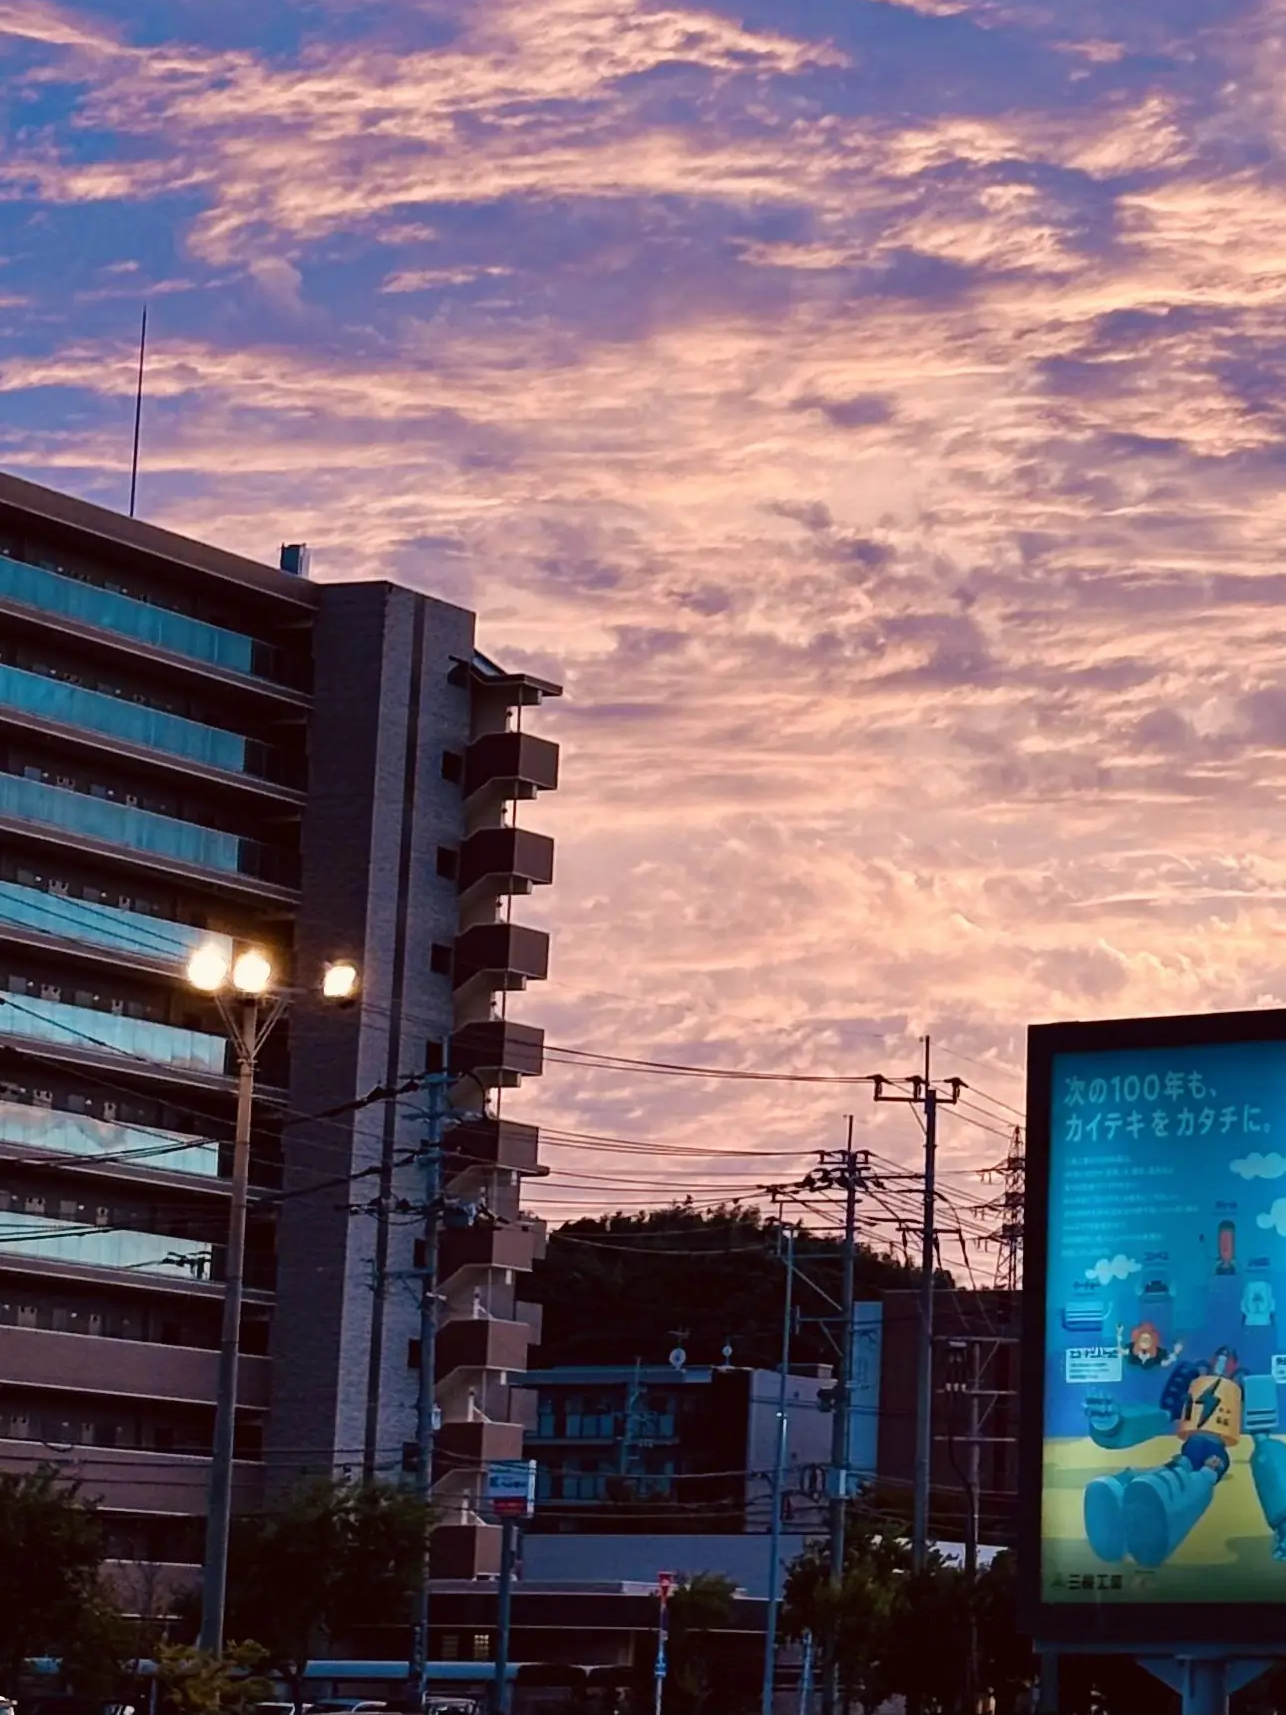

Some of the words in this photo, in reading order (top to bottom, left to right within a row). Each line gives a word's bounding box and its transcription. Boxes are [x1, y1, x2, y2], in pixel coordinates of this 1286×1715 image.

[1063, 1071, 1217, 1106] 次の100年も、
[1065, 1105, 1271, 1142] カイテキをカタチに。
